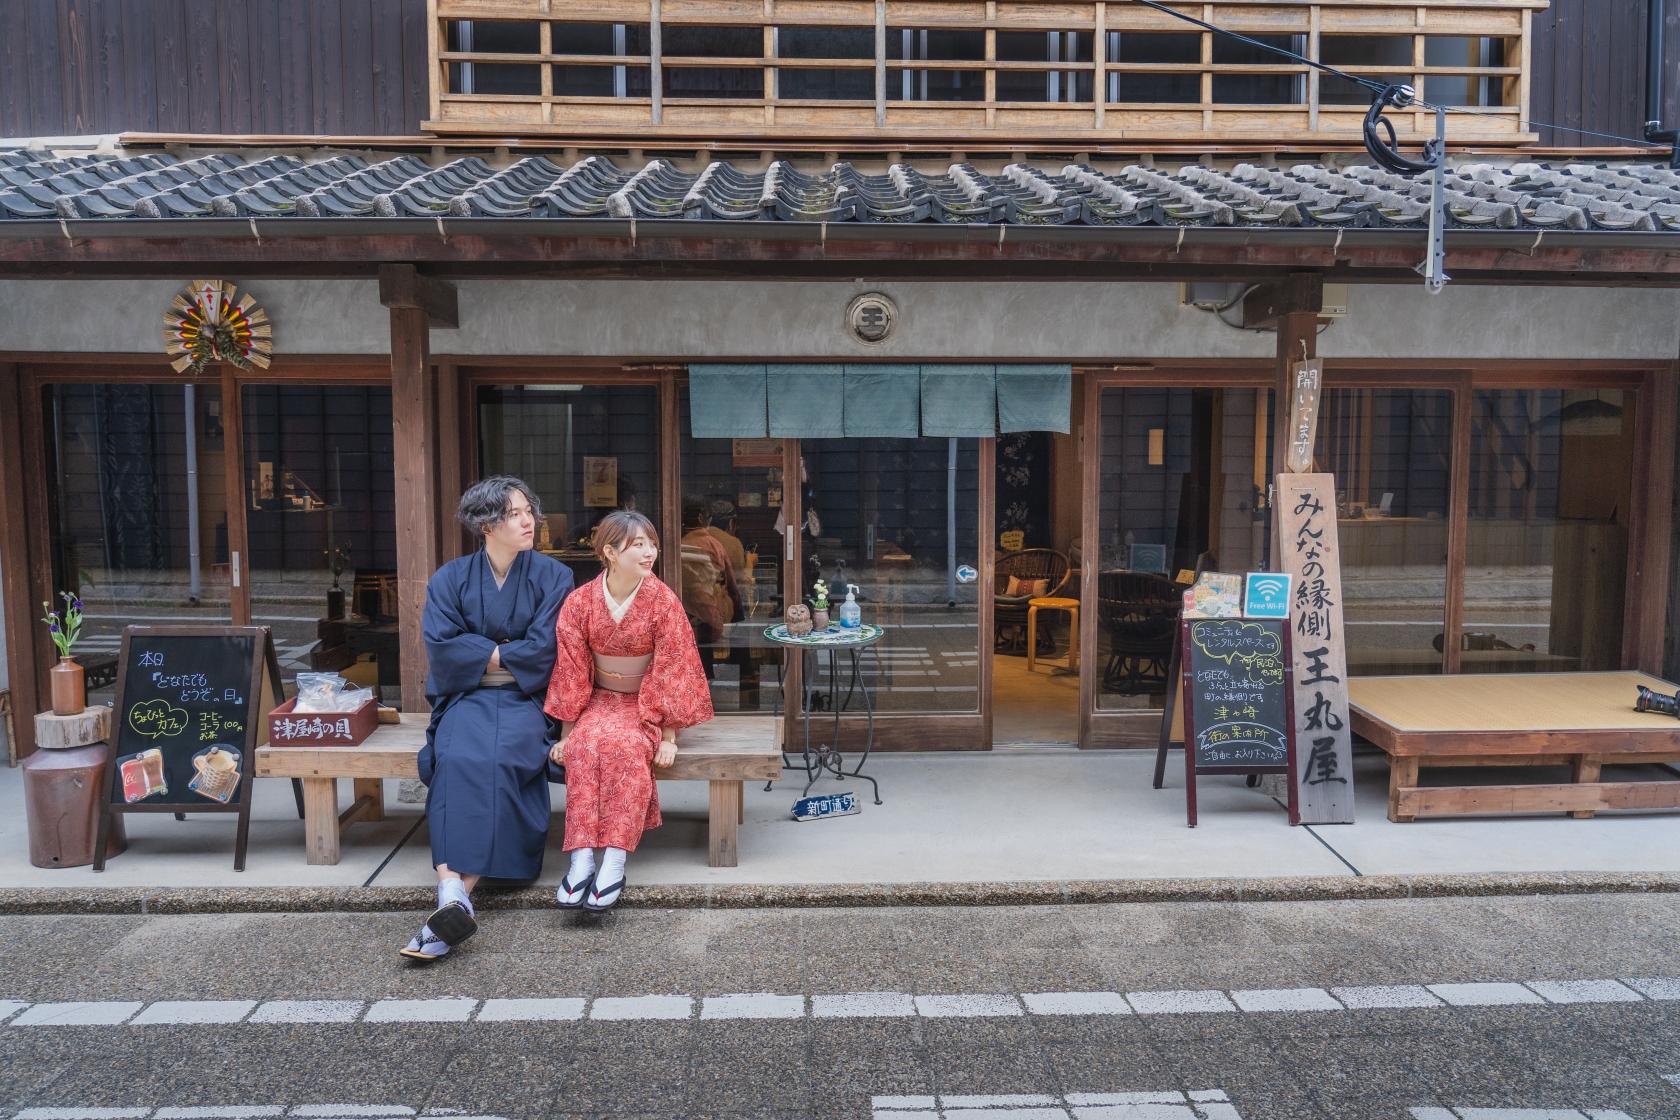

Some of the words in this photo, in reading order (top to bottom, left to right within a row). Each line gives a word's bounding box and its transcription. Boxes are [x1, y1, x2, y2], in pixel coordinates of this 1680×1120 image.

[1250, 602, 1265, 610] Free
[1267, 602, 1285, 610] Wi-Fi
[138, 650, 164, 667] 本日
[200, 711, 222, 721] コーヒー
[200, 721, 220, 731] コーラ
[273, 717, 353, 741] 津屋崎の貝
[808, 795, 853, 815] 新町通り
